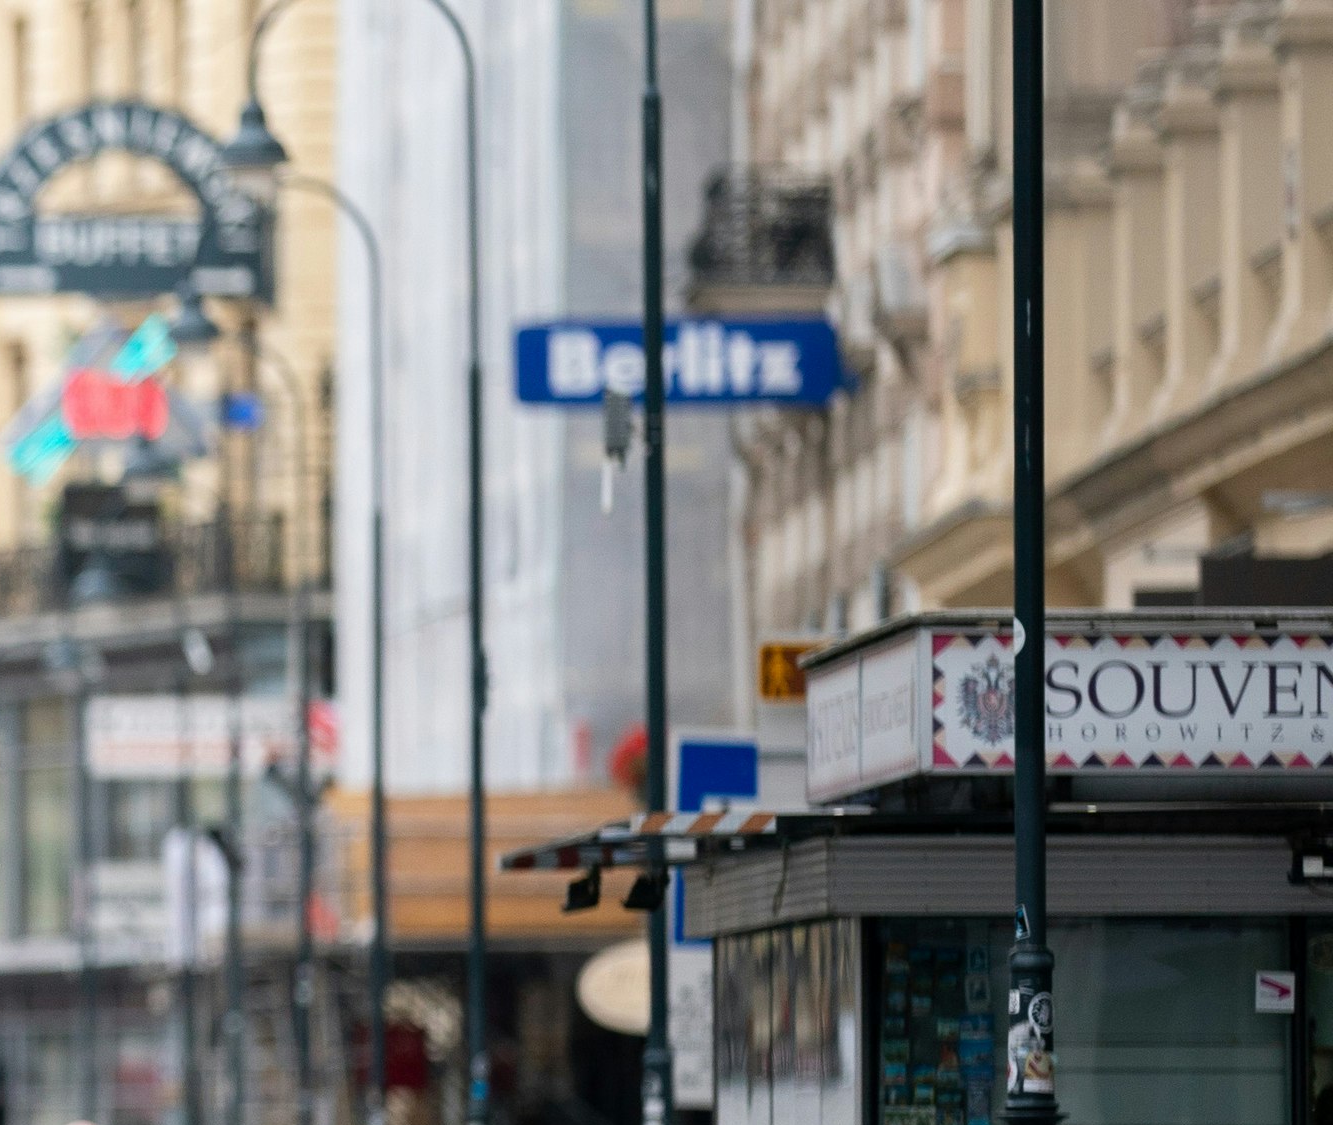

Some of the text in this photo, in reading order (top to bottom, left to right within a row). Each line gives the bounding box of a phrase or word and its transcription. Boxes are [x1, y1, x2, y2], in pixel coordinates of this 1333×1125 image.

[36, 218, 202, 264] BUFFET
[548, 327, 802, 397] Berlitz
[1047, 722, 1326, 744] HOROWITZ &
